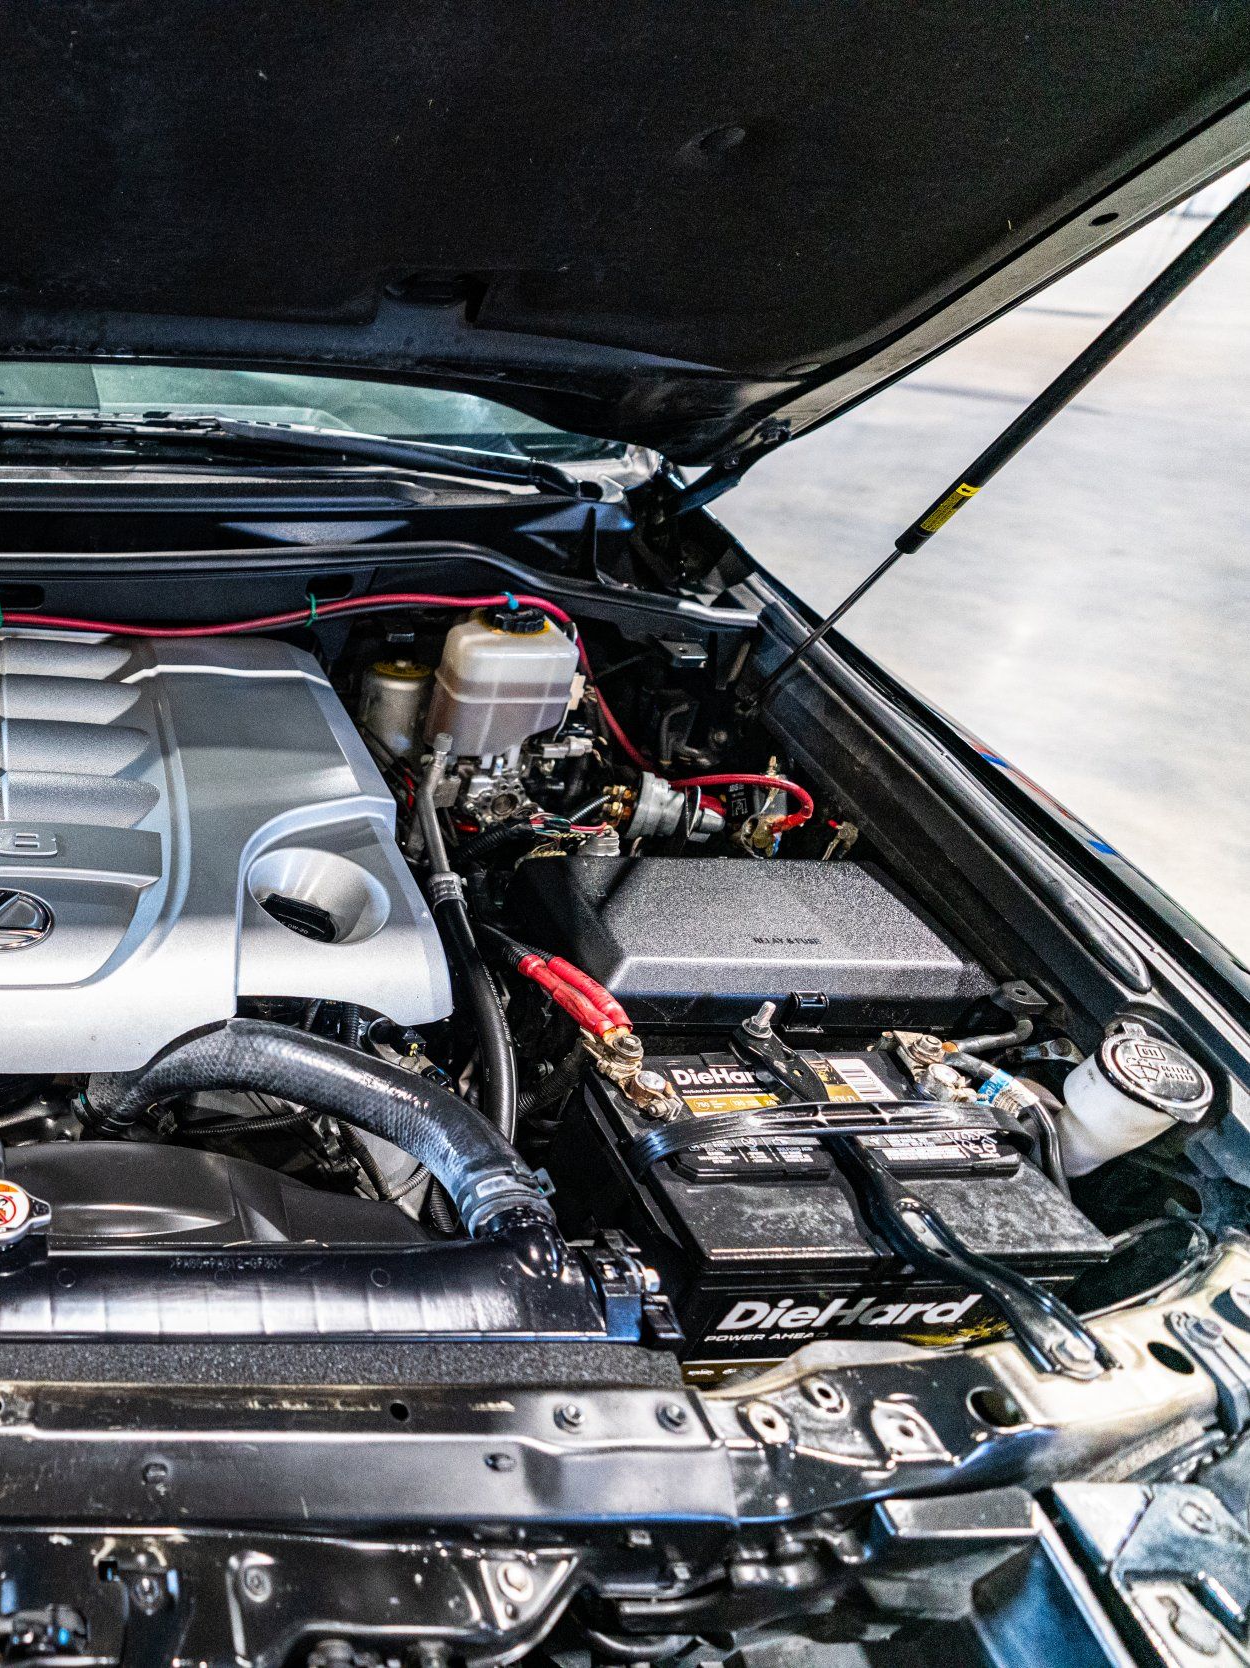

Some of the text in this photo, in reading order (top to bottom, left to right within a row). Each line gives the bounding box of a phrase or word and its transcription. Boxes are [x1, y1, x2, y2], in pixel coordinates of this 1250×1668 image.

[671, 1068, 755, 1086] DieHar
[716, 1293, 984, 1331] DieHard
[704, 1331, 828, 1342] POWER AHEAD
